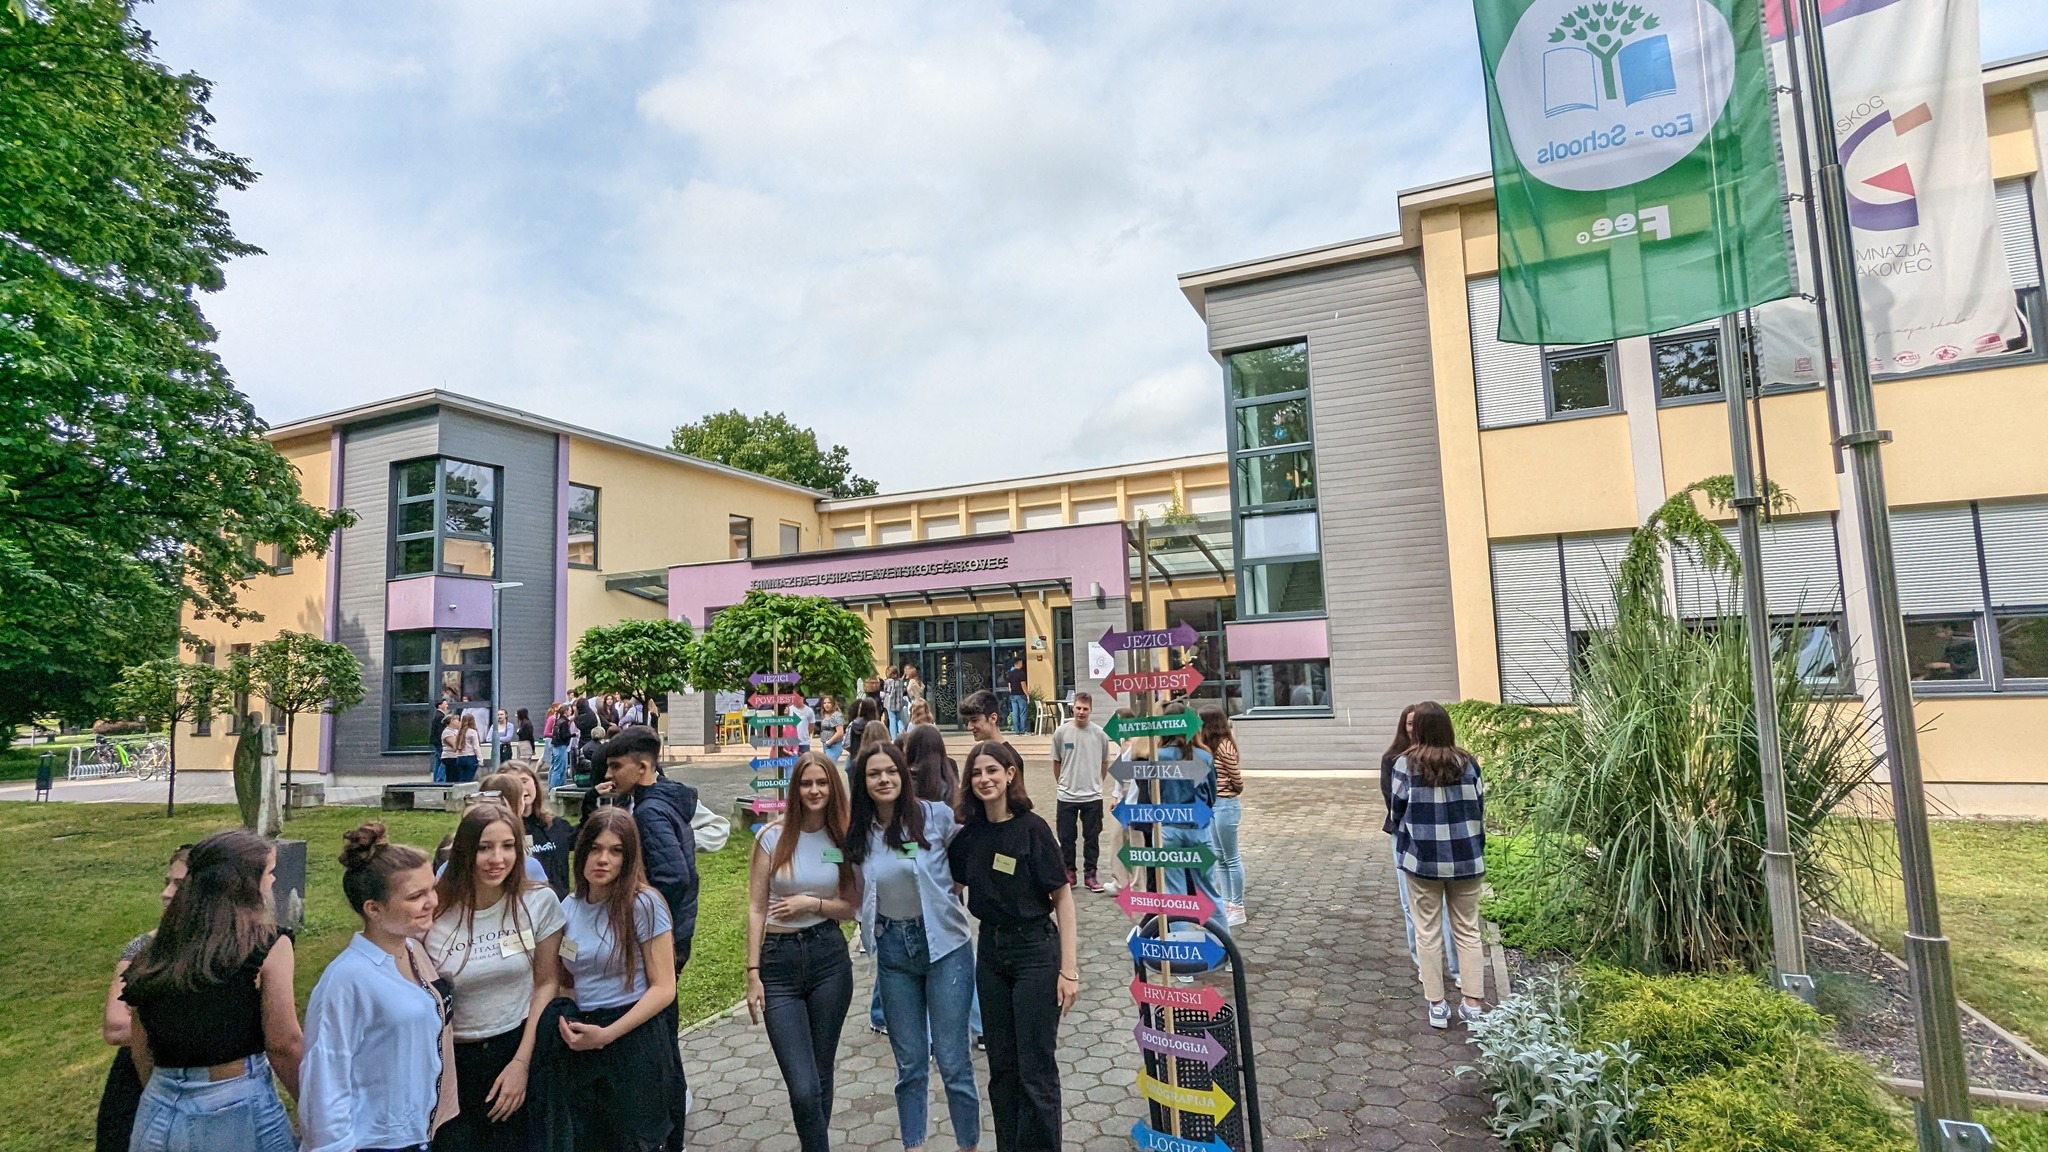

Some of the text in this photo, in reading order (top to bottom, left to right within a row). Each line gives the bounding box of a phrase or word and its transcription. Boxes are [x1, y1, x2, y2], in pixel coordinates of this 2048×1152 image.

[1855, 242, 1931, 261] MNAZIJA
[1856, 258, 1933, 277] AKOVEC
[751, 557, 1008, 590] GIMNAZIJA JOSIPA SLAVENSKOG ČAKOVEC
[1122, 632, 1173, 649] JEZICI
[760, 674, 789, 683] JEZICI
[1113, 673, 1190, 692] POVIJEST
[755, 695, 796, 705] POVIJEST
[1118, 719, 1188, 732] MATEMATIKA
[762, 739, 789, 747] FIZIKA
[759, 759, 793, 768] LIKOVNI
[1132, 765, 1184, 779] FIZIKA
[1129, 808, 1194, 822] LIKOVNI
[1129, 850, 1203, 863] BIOLOGIJA
[1130, 896, 1200, 910] PSIHOLOGIJA
[1141, 943, 1203, 960] KEMIJA
[1143, 987, 1202, 1005] HRVATSKI
[1141, 1031, 1209, 1054] SOCIOLOGIJA
